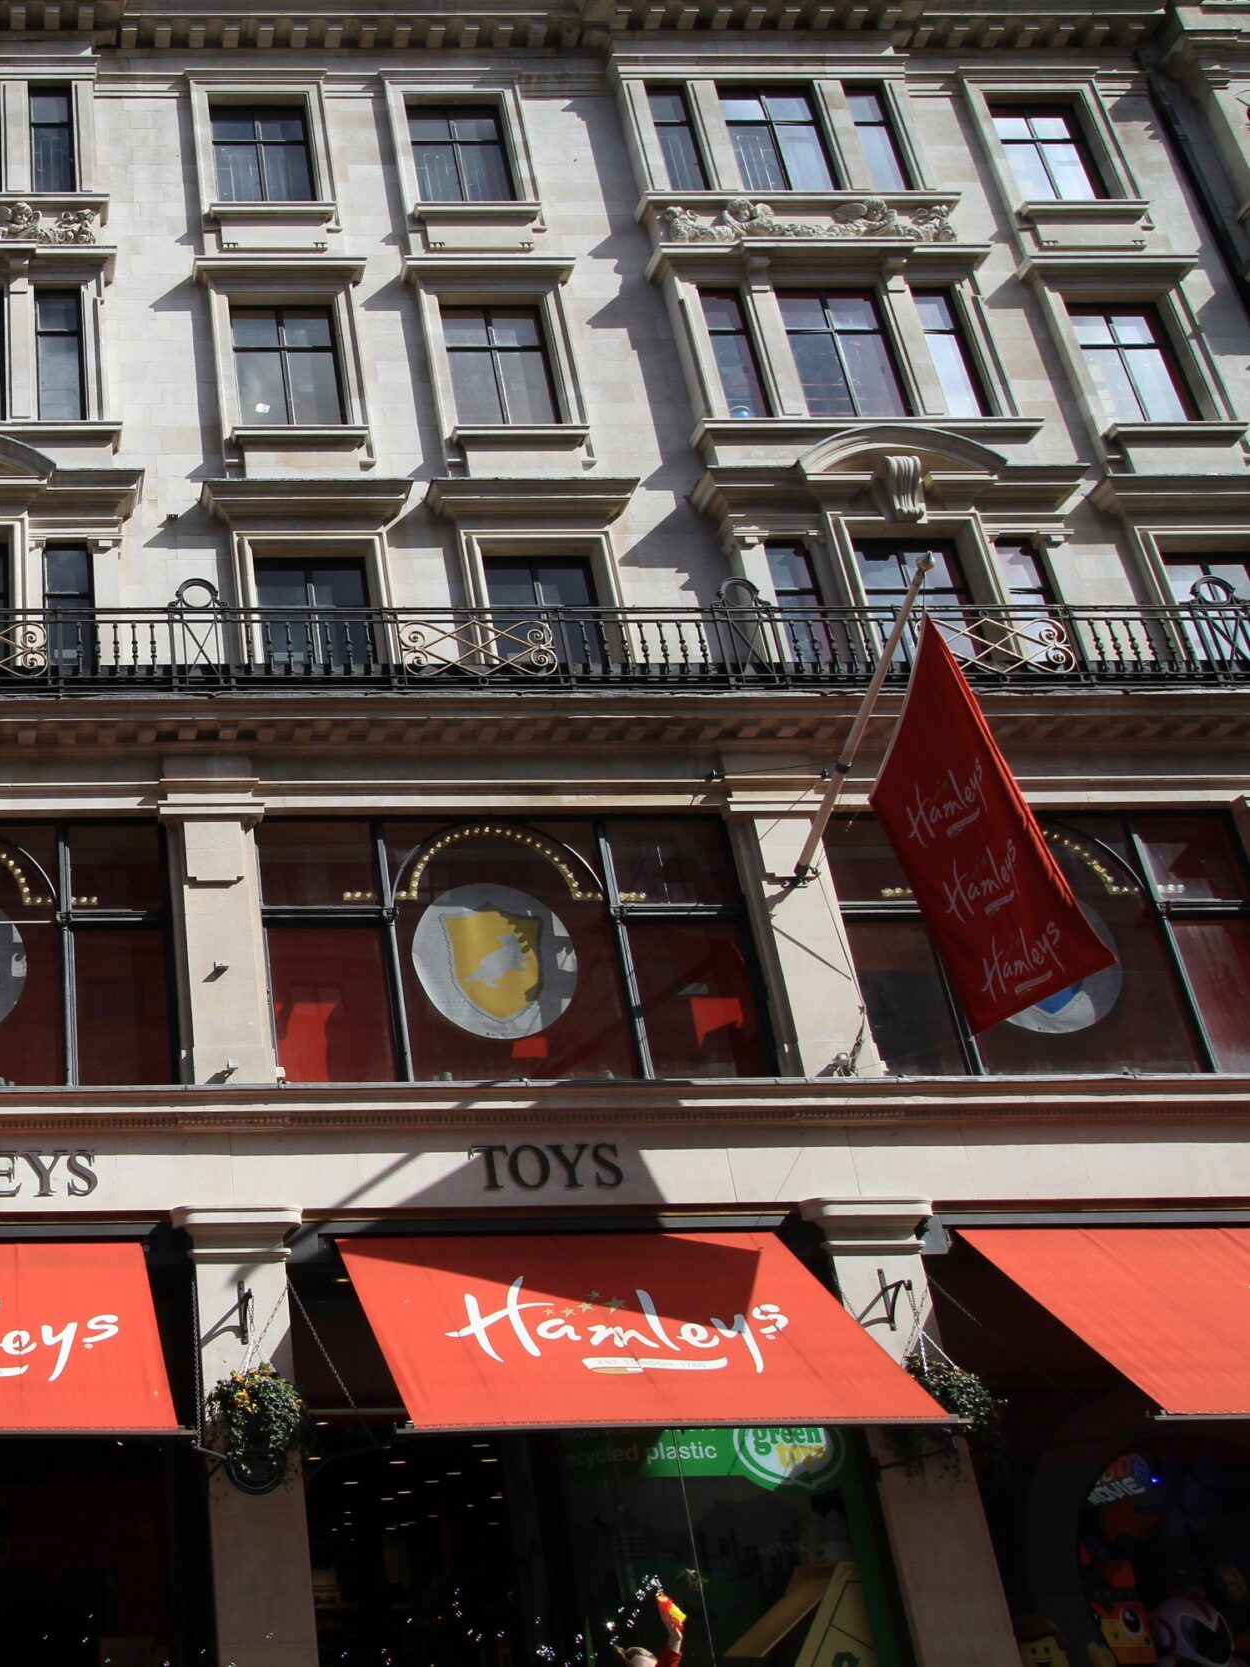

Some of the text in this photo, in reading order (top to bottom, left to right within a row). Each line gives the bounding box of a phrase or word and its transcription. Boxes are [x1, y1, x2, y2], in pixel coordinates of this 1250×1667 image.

[906, 757, 988, 848] Hamleys
[943, 839, 1020, 924] Hamleys
[982, 921, 1066, 1003] Hamleys
[468, 1143, 624, 1190] TOYS
[444, 1275, 789, 1375] Hamleys
[647, 1441, 718, 1465] plastic
